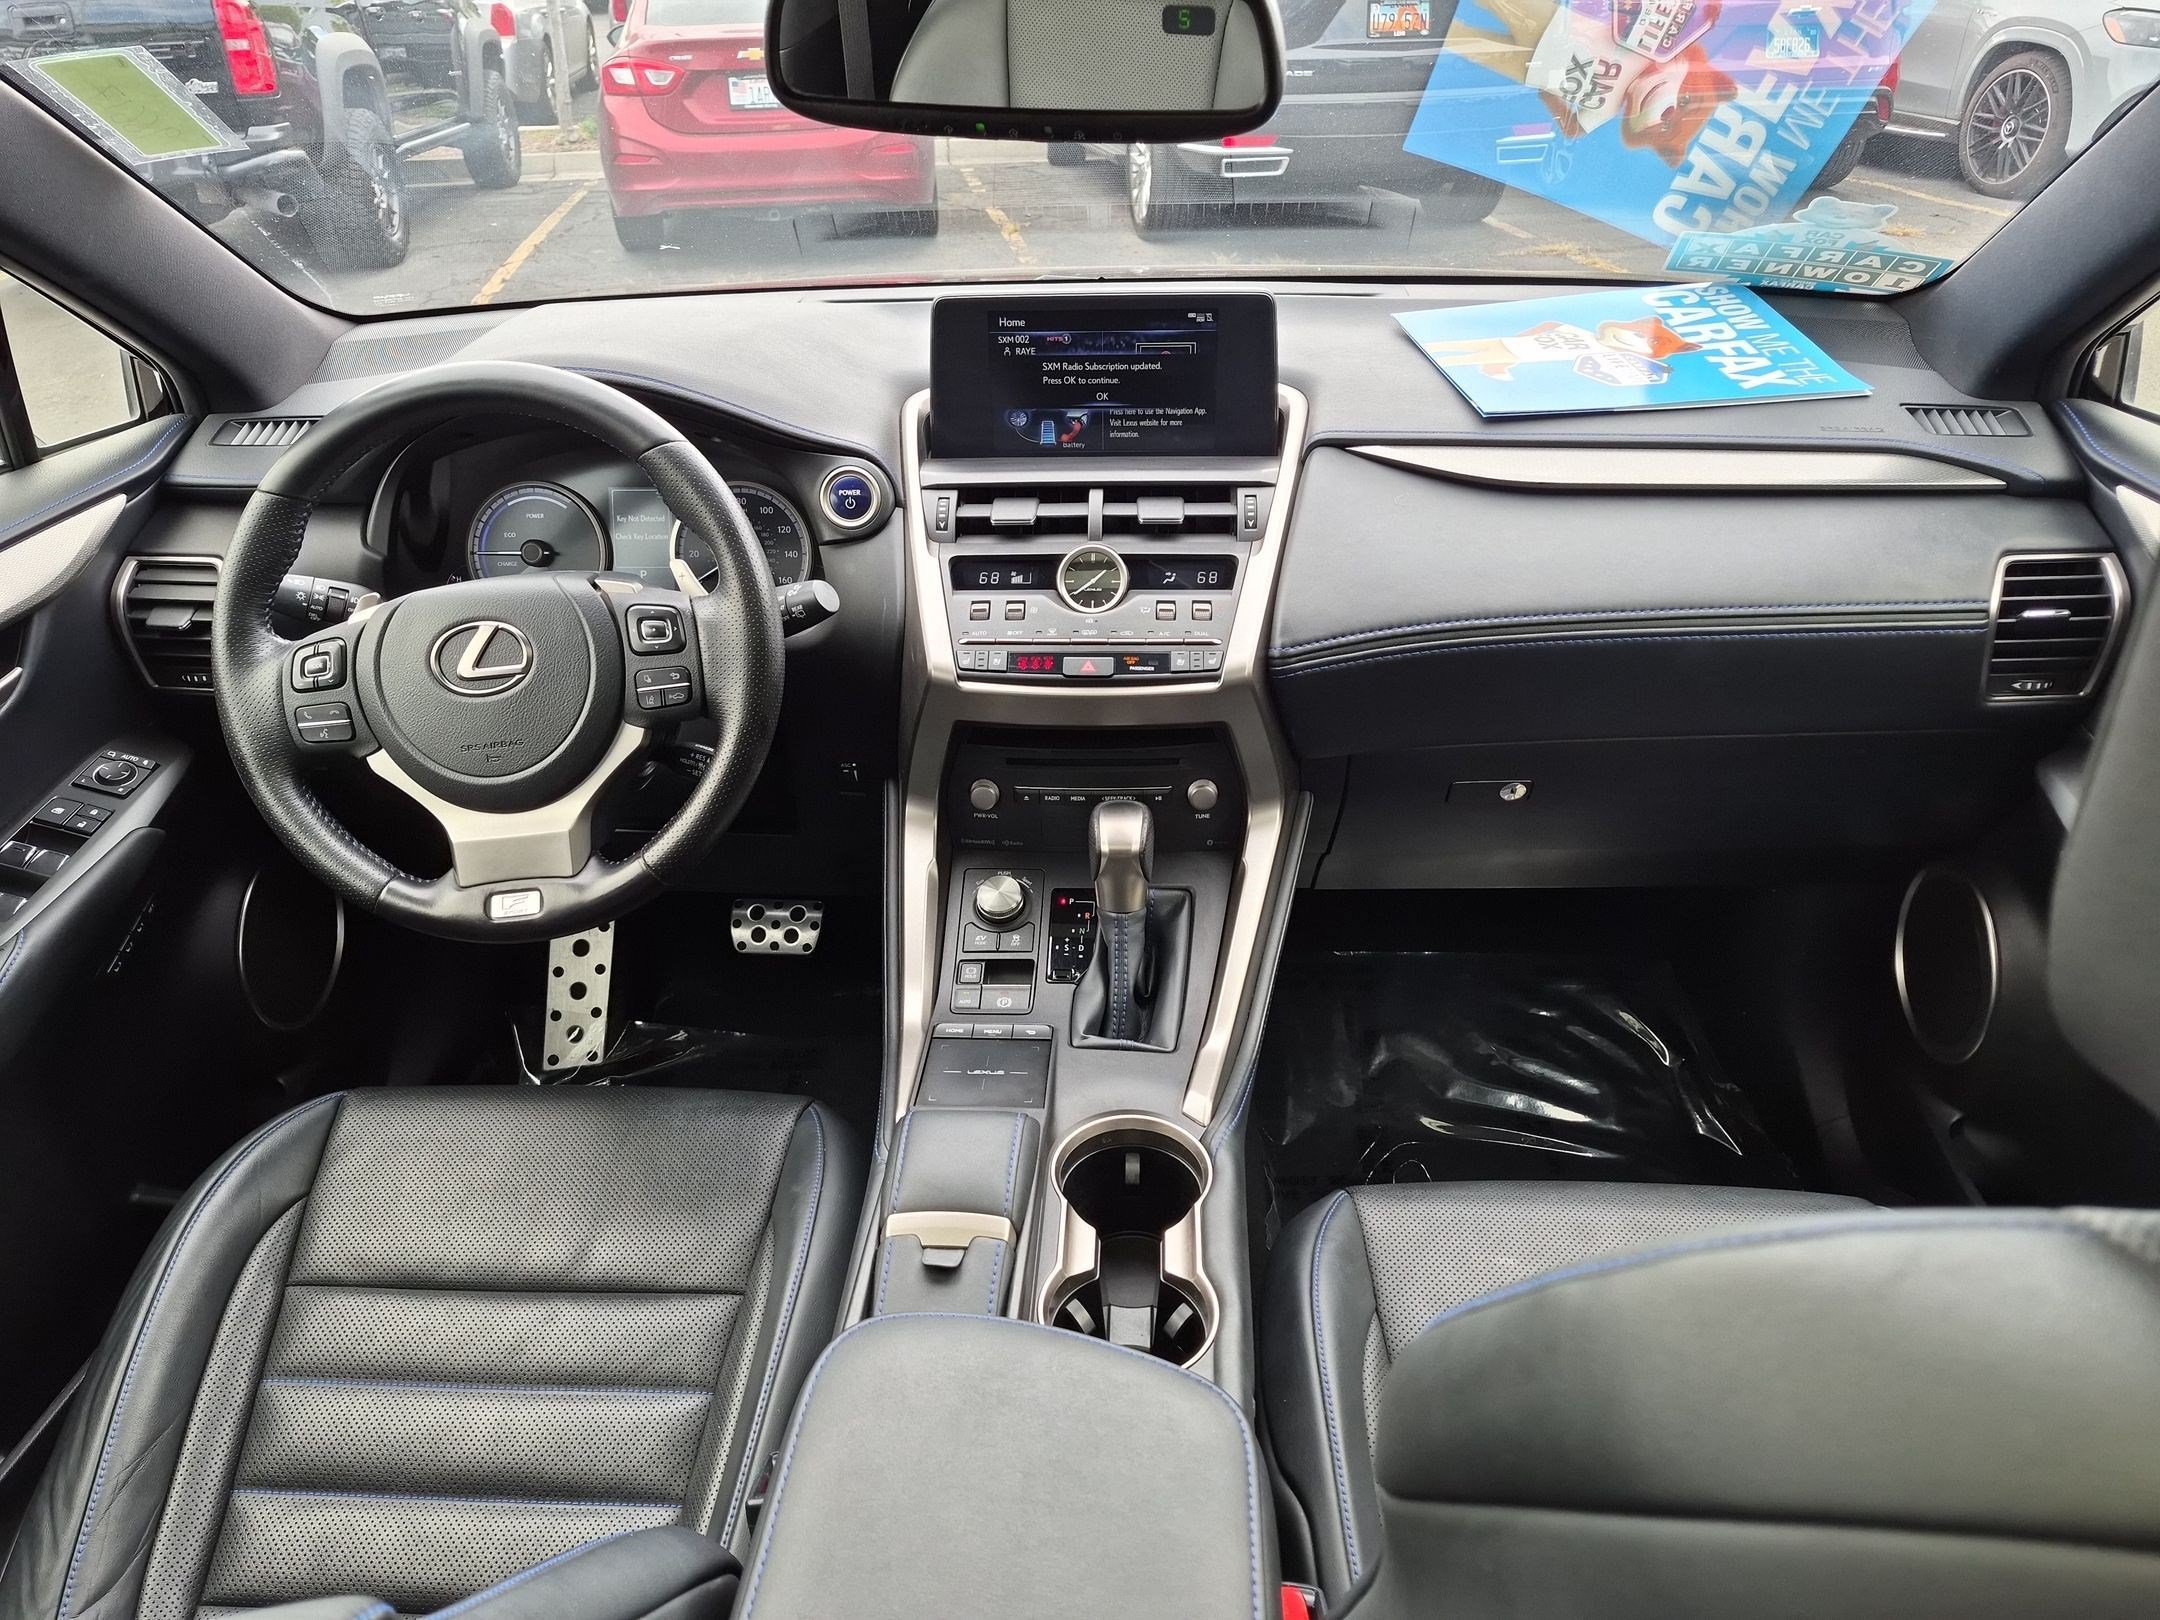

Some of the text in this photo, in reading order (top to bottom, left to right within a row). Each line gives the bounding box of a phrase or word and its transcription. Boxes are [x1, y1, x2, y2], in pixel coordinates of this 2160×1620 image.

[999, 317, 1026, 327] Home
[998, 335, 1030, 344] SXM 002
[1643, 289, 1810, 389] CARFAX
[1699, 285, 1837, 386] SHOW ME THE
[1015, 347, 1036, 355] RAYE
[1042, 362, 1163, 372] SXM Radio Subscription updated.
[1042, 376, 1121, 385] Press OK to continue.
[1096, 392, 1109, 401] OK
[1165, 407, 1194, 416] Navigation
[1194, 407, 1208, 416] App.
[1160, 418, 1168, 426] for
[1109, 430, 1140, 438] information.
[759, 506, 774, 515] 100
[616, 514, 666, 523] Key Not Detected
[777, 526, 792, 534] 120
[632, 533, 644, 541] Key
[689, 551, 700, 559] 20
[784, 550, 799, 559] 140
[778, 576, 793, 584] 160
[978, 571, 1000, 585] 68
[1196, 571, 1219, 584] 68
[121, 753, 139, 762] AUTO
[1064, 944, 1070, 952] S
[1078, 944, 1085, 952] D
